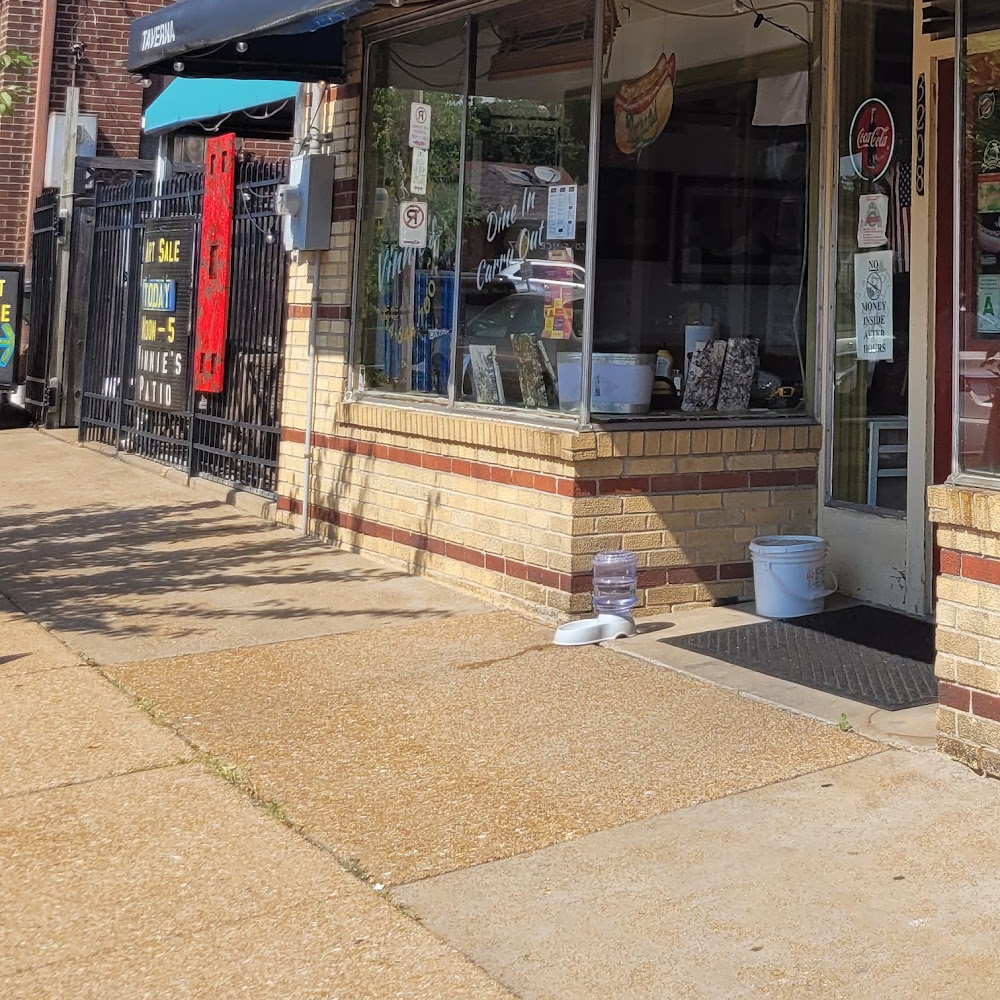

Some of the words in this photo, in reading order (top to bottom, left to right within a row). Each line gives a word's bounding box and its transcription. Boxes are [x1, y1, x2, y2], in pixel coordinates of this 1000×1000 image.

[141, 19, 175, 52] TAVERNA
[486, 204, 518, 242] Dine
[522, 187, 536, 217] In
[158, 237, 180, 263] SALE
[868, 259, 879, 271] NO
[144, 282, 170, 309] TODAY
[861, 301, 887, 311] MONEY
[863, 315, 885, 326] INSIDE
[863, 330, 885, 340] AFTER
[863, 343, 886, 353] HOURS
[139, 375, 172, 407] PATIO
